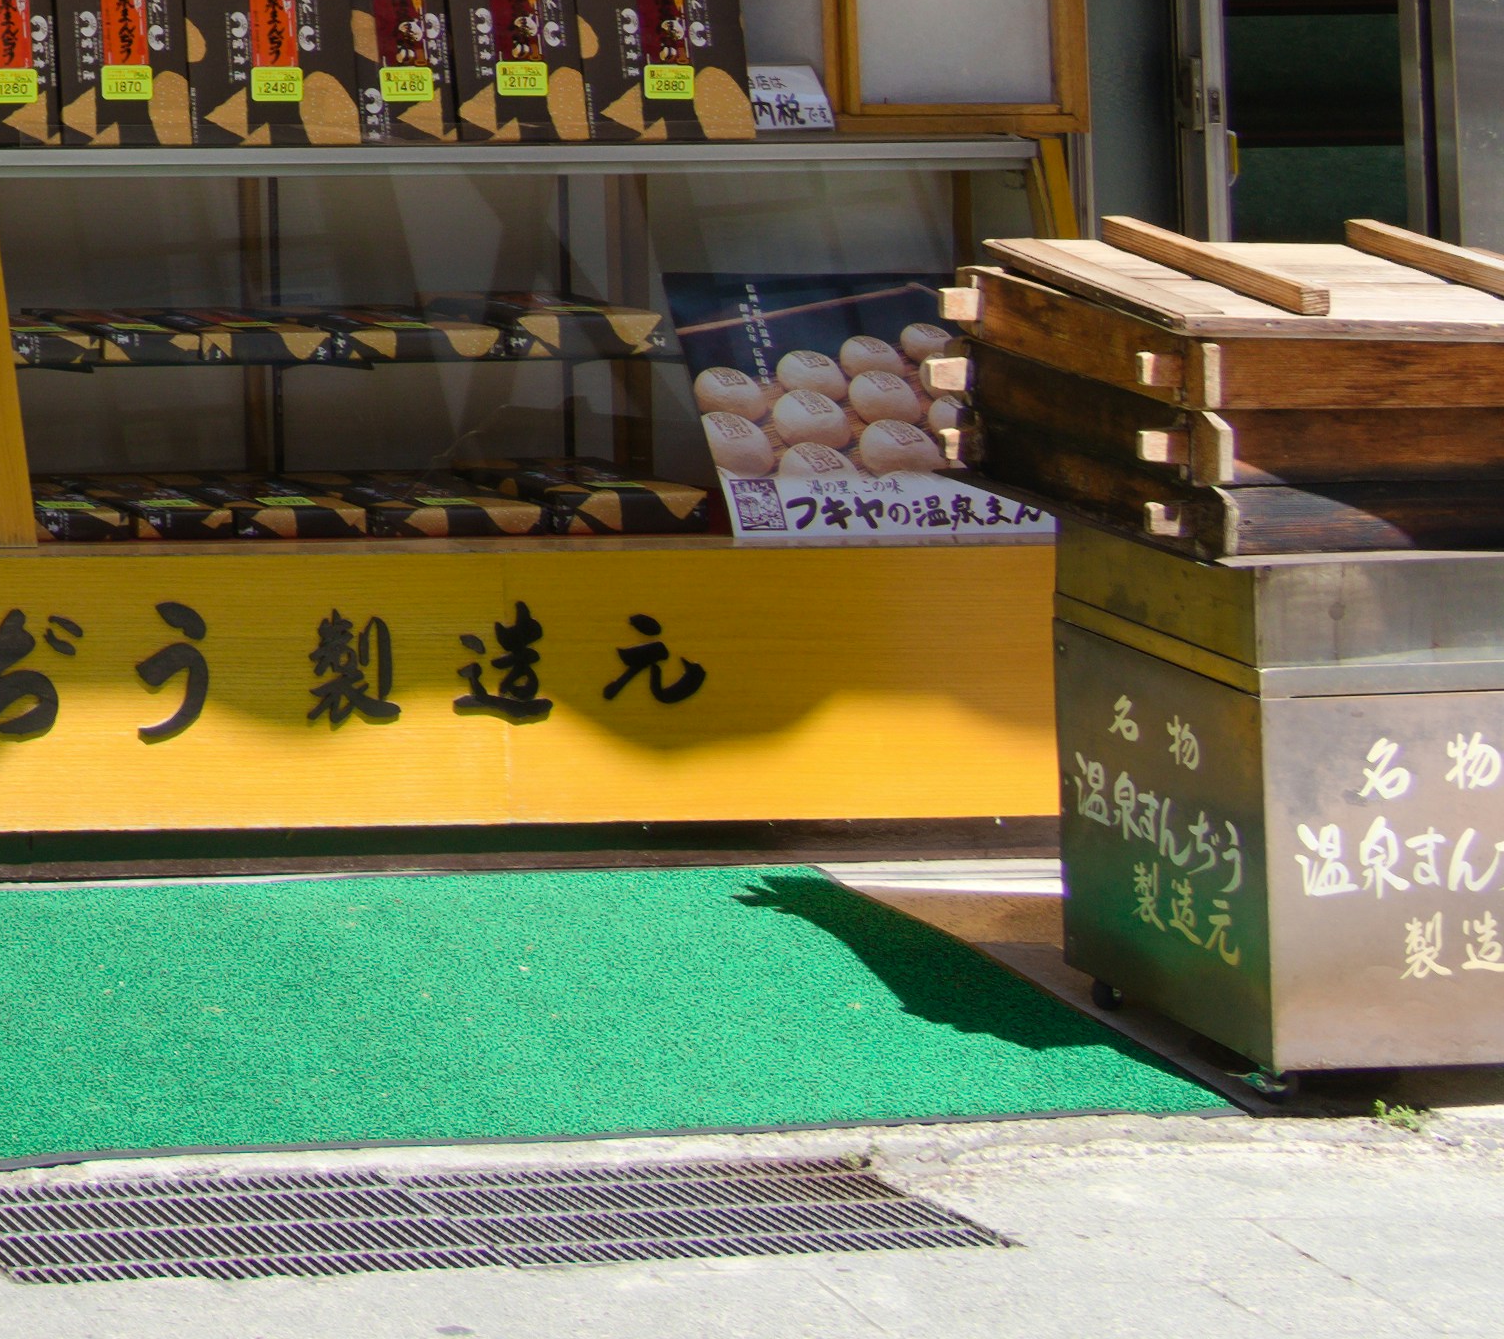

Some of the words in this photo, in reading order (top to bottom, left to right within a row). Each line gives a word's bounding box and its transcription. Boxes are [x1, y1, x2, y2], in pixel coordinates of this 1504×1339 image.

[785, 493, 1056, 531] フキヤの温泉まん
[1108, 694, 1200, 770] 名物
[1357, 731, 1501, 800] 名物
[1075, 752, 1244, 893] 温泉まんぢう
[1294, 816, 1504, 899] 温泉まん
[1131, 861, 1242, 966] 製造元
